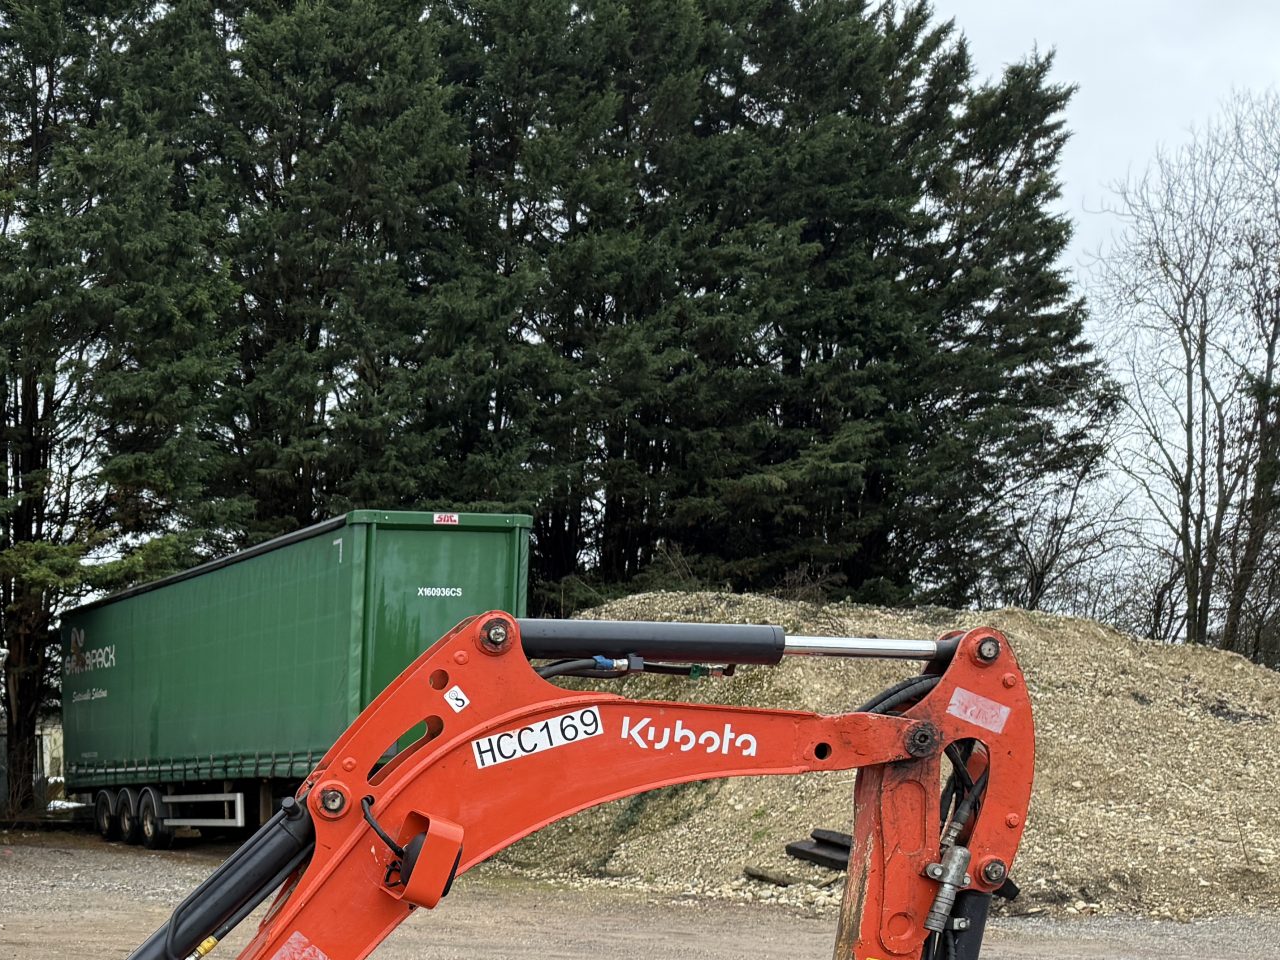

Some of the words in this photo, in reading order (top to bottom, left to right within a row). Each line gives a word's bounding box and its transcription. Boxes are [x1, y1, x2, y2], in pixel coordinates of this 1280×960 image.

[417, 587, 462, 597] X160936CS
[475, 709, 599, 767] HCC169
[621, 716, 757, 757] Kubota
